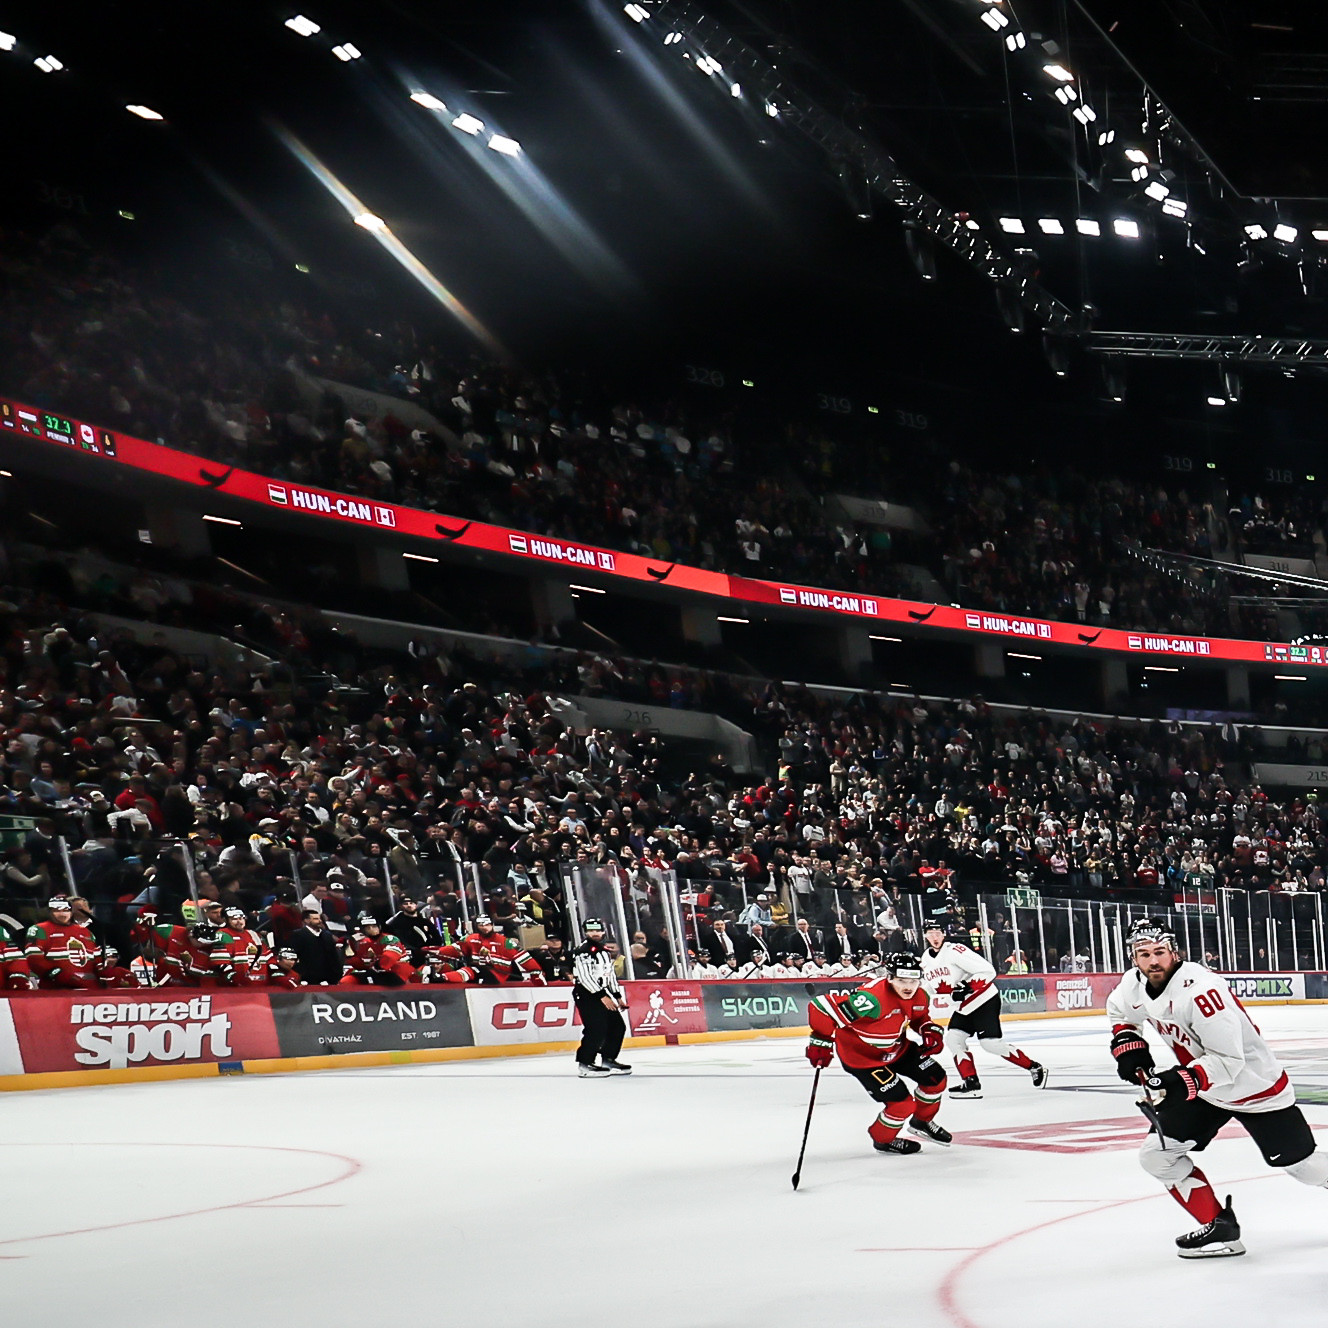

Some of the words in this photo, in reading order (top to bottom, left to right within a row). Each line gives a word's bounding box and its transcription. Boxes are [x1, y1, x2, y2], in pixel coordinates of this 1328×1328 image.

[896, 409, 928, 430] 319
[1164, 454, 1192, 472] 319
[1264, 467, 1294, 484] 318
[292, 490, 371, 520] HUN-CAN
[531, 540, 595, 565] HUN-CAN
[800, 590, 859, 612] HUN-CAN
[983, 617, 1035, 635] HUN-CAN
[1145, 634, 1194, 652] HUN-CAN
[624, 709, 652, 725] 216
[1306, 771, 1328, 783] 215
[853, 995, 875, 1012] 87
[1057, 985, 1093, 1011] sport
[1194, 988, 1226, 1018] 80
[71, 995, 211, 1023] nemzeti
[312, 1001, 437, 1024] ROLAND
[74, 1013, 232, 1068] sport
